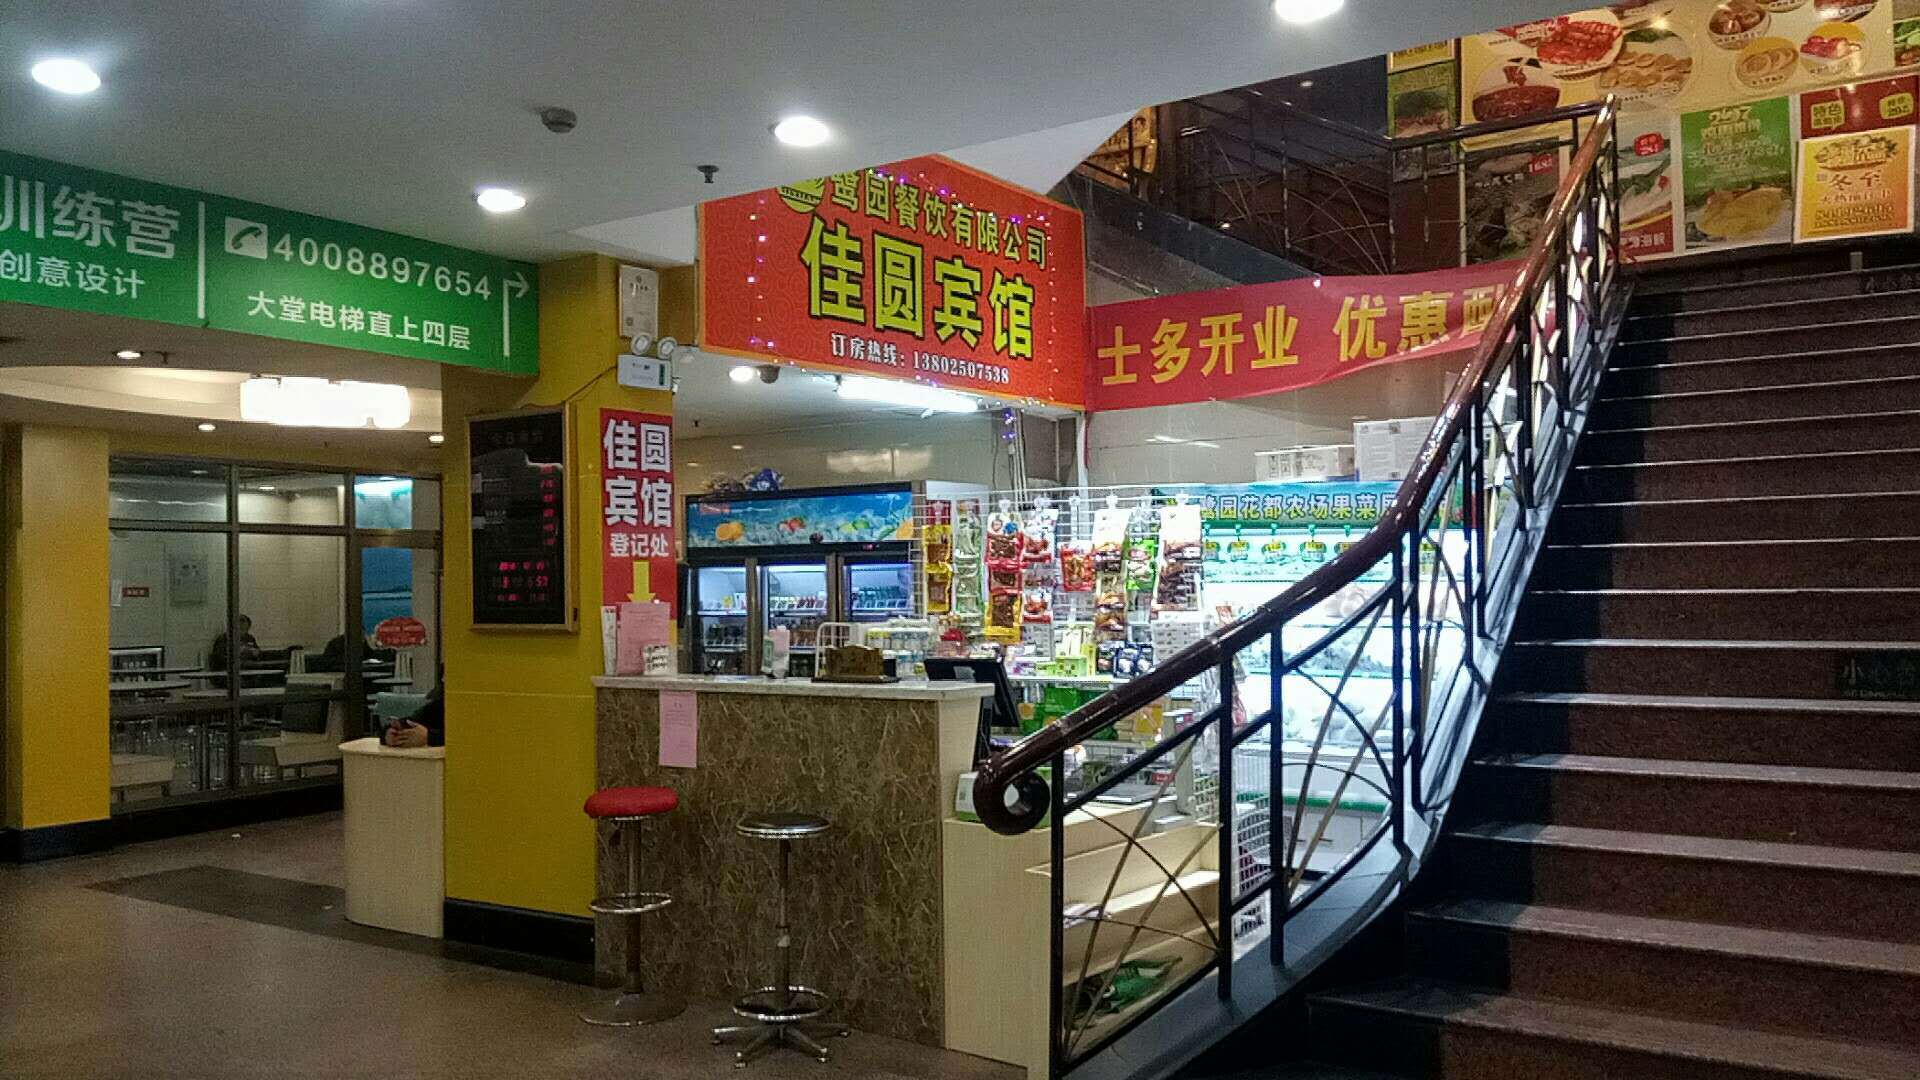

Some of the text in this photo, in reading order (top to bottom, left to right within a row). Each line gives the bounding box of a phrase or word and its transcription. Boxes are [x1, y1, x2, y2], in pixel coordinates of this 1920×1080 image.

[0, 249, 146, 299] 创意设计
[273, 233, 492, 301] 4008897654
[800, 215, 1036, 360] 佳圆宾馆
[247, 290, 472, 351] 大堂电梯直上四层
[1097, 304, 1299, 387] 士多开业
[603, 418, 672, 473] 佳圆
[604, 475, 673, 529] 宾馆
[609, 532, 670, 558] 登记处
